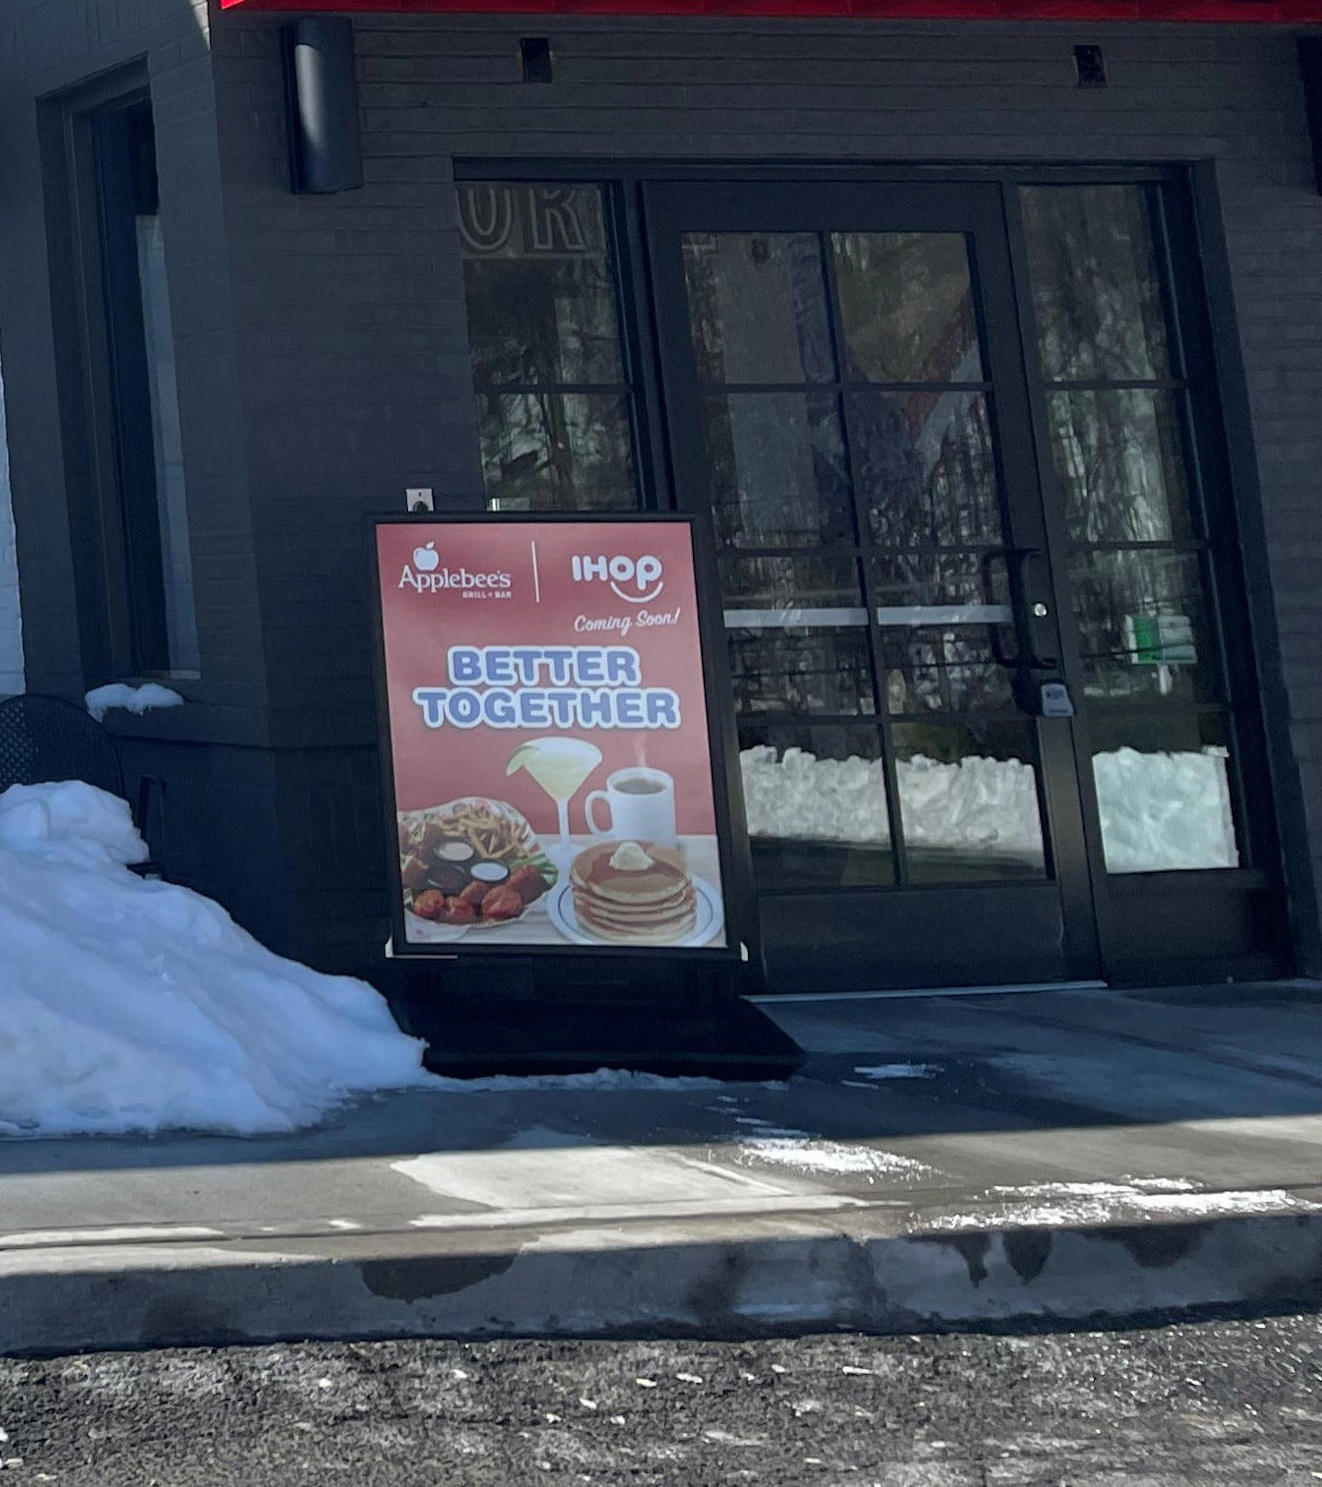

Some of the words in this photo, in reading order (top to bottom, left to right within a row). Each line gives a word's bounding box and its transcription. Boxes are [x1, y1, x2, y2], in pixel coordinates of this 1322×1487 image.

[397, 564, 512, 594] Applebee's
[574, 613, 633, 636] Coming
[635, 607, 681, 628] Soon!
[448, 646, 642, 687] BETTER
[413, 687, 682, 729] TOGETHER
